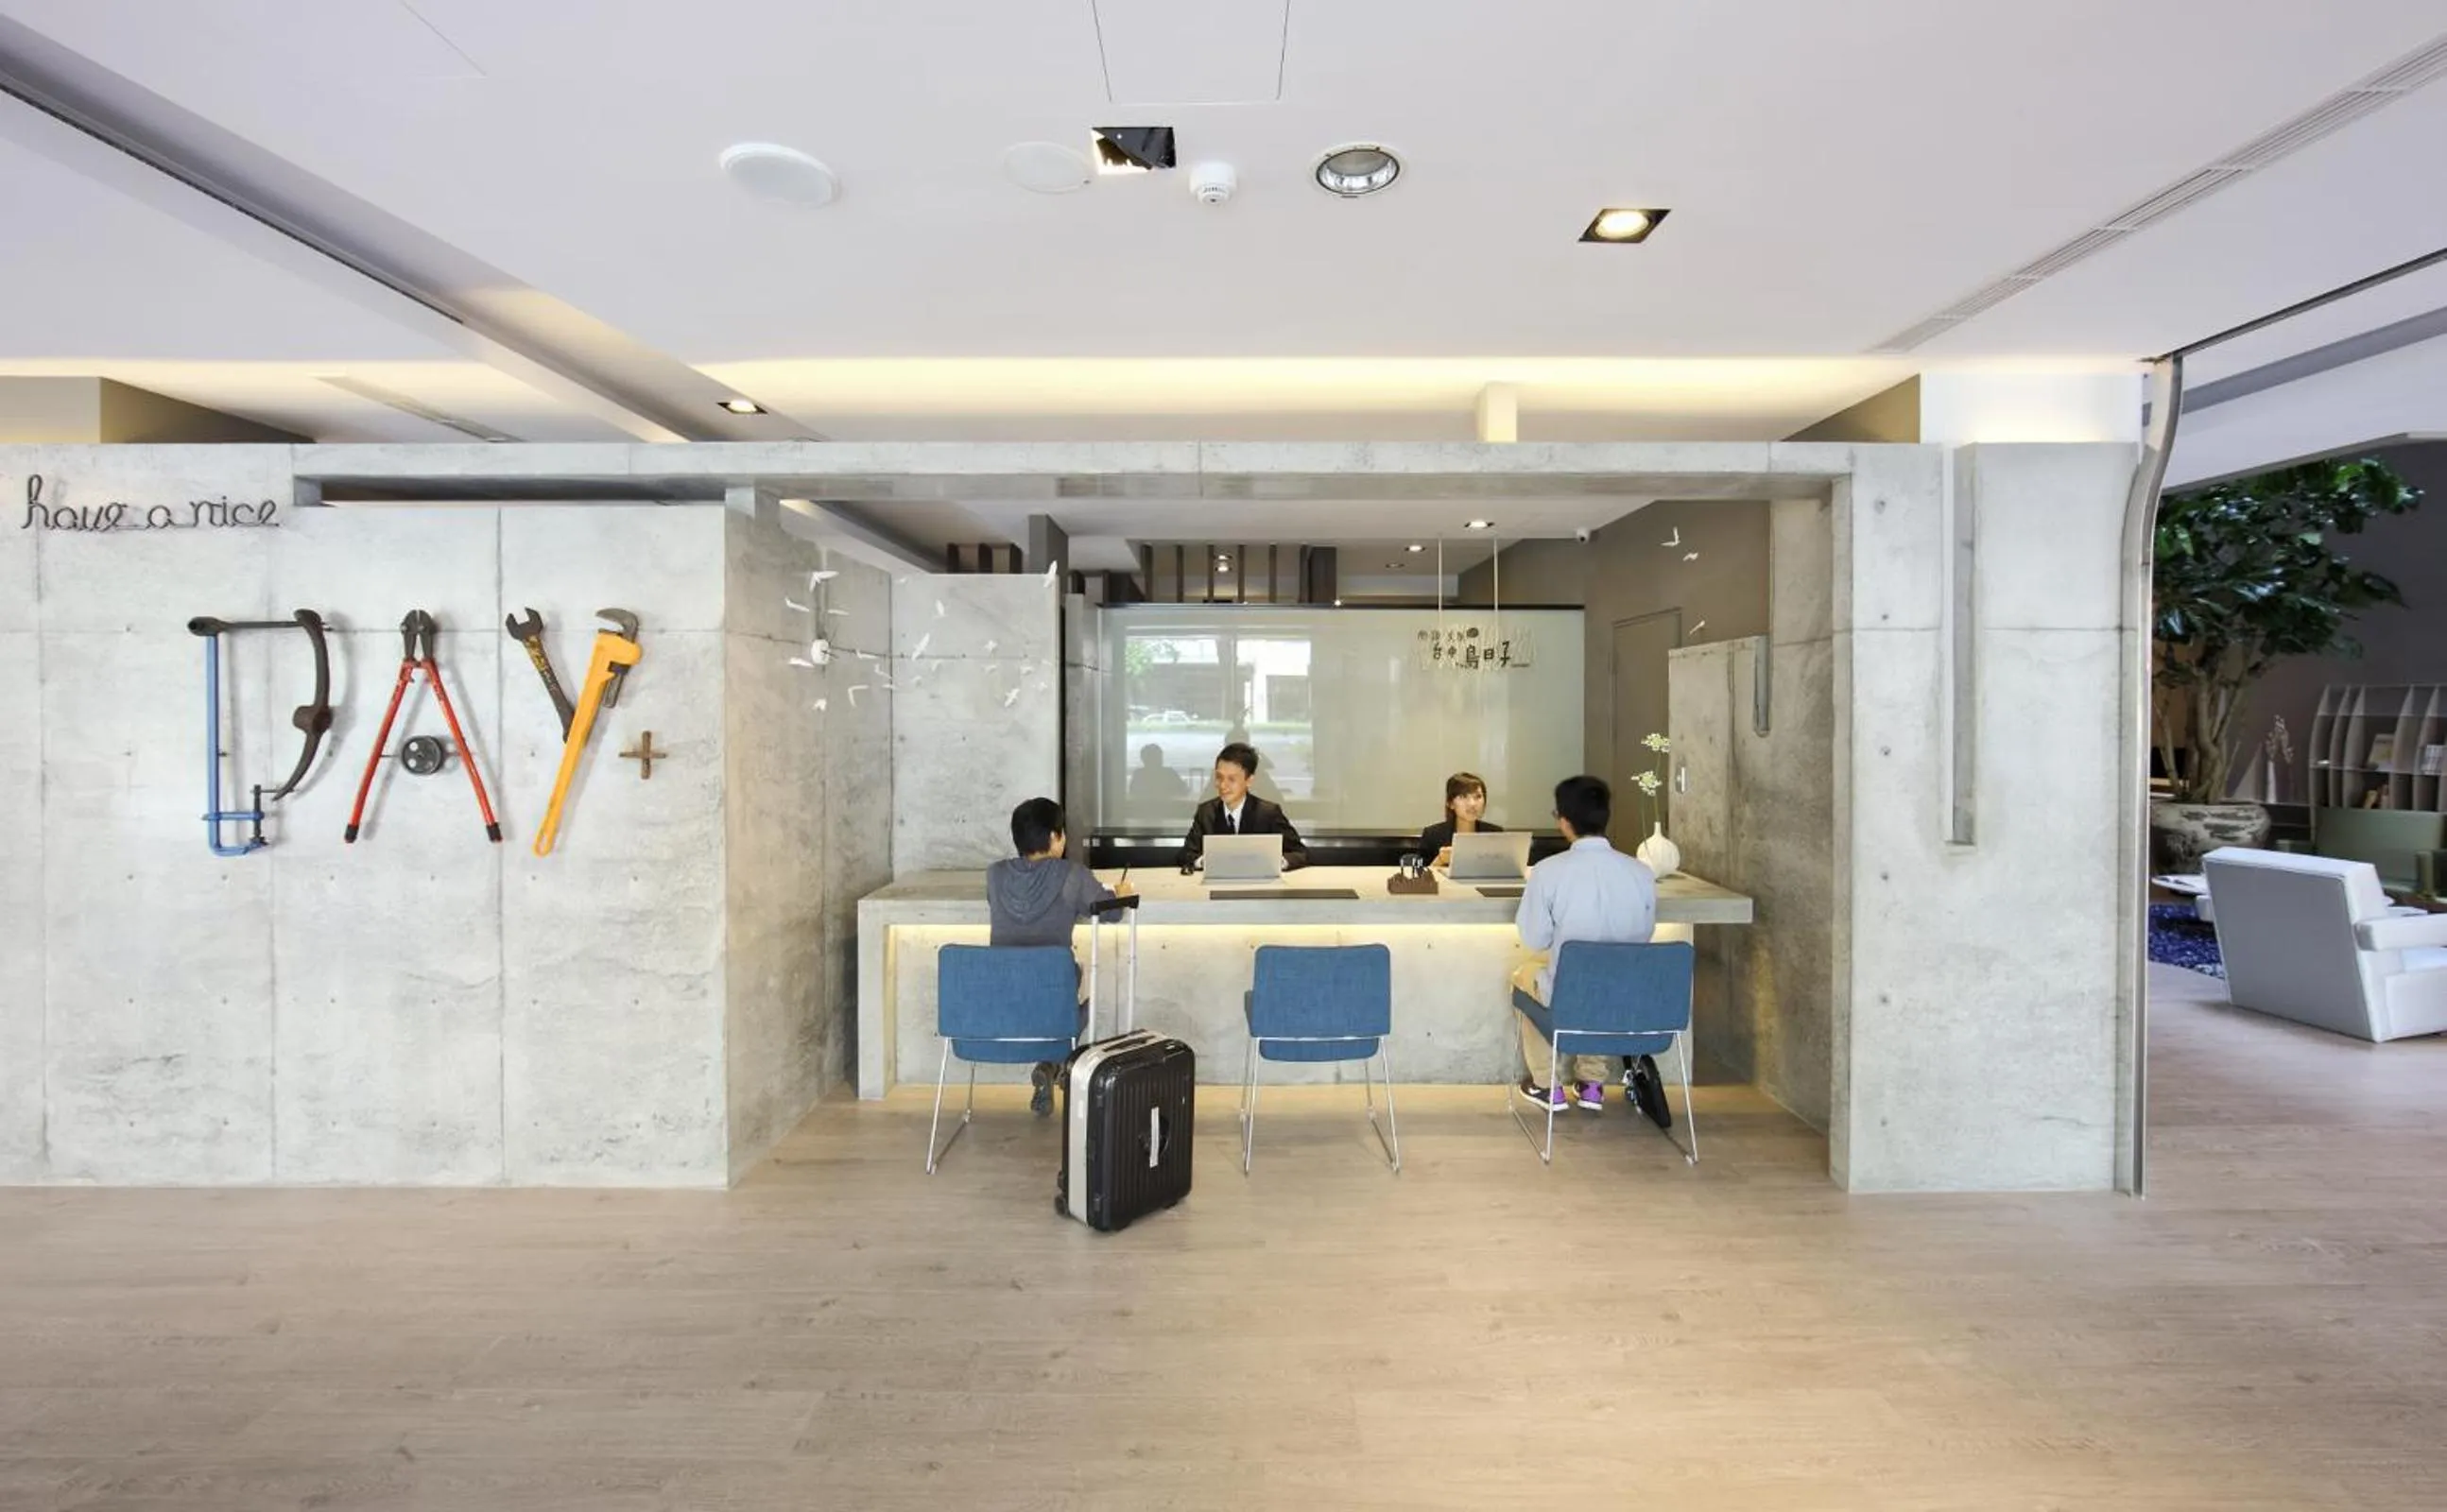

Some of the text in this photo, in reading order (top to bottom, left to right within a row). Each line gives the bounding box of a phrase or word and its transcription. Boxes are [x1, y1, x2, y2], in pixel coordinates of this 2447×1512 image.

[22, 474, 280, 531] have a nice
